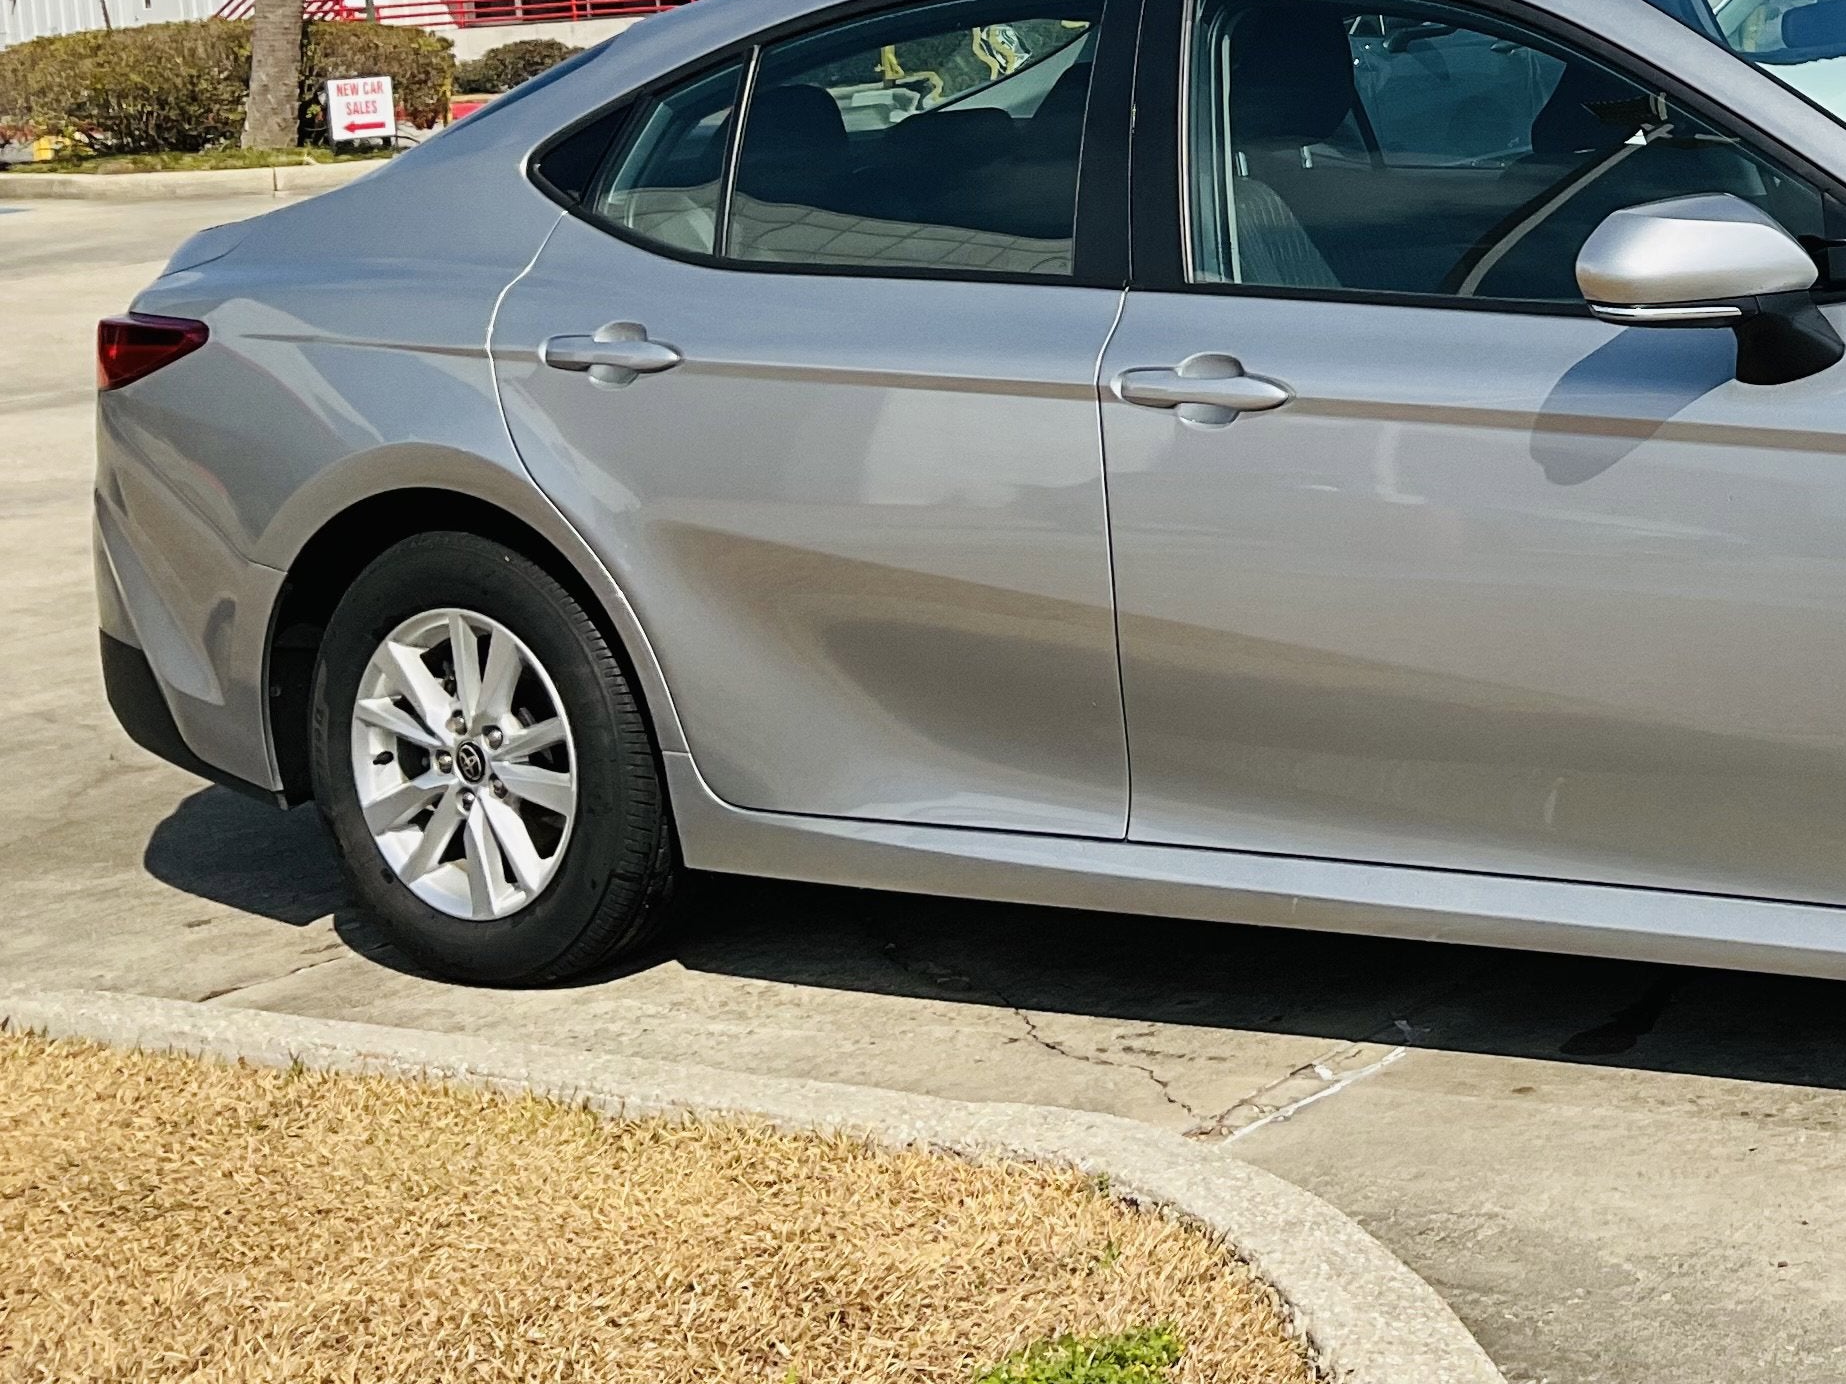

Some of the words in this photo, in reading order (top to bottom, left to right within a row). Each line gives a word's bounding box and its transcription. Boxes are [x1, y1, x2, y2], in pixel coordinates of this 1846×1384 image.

[336, 82, 359, 96] NEW
[362, 80, 384, 95] CAR
[346, 100, 378, 116] SALES
